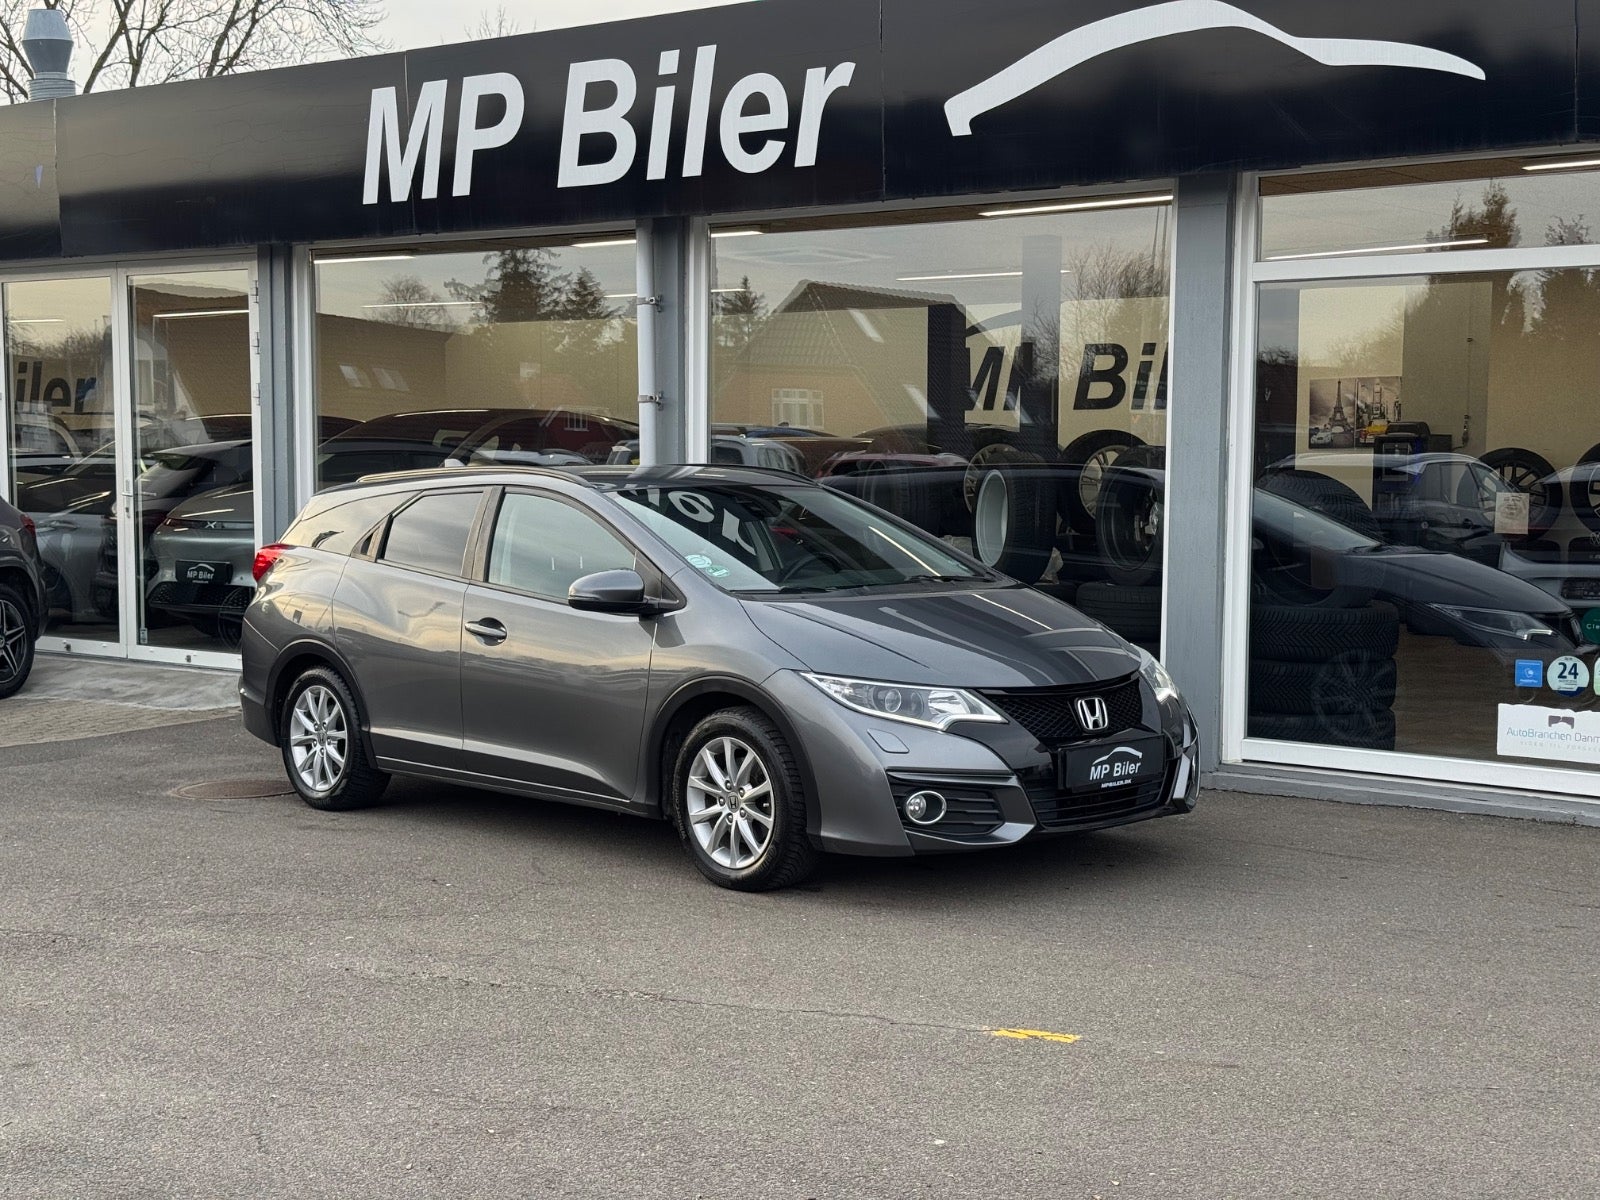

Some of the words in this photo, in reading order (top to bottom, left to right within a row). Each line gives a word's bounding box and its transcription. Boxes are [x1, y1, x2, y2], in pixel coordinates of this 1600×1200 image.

[362, 72, 525, 205] MP
[557, 44, 857, 188] Biler
[1557, 662, 1579, 679] 24
[1506, 727, 1572, 741] AutoBranchen
[1090, 764, 1110, 780] MP
[1113, 761, 1141, 777] Biler
